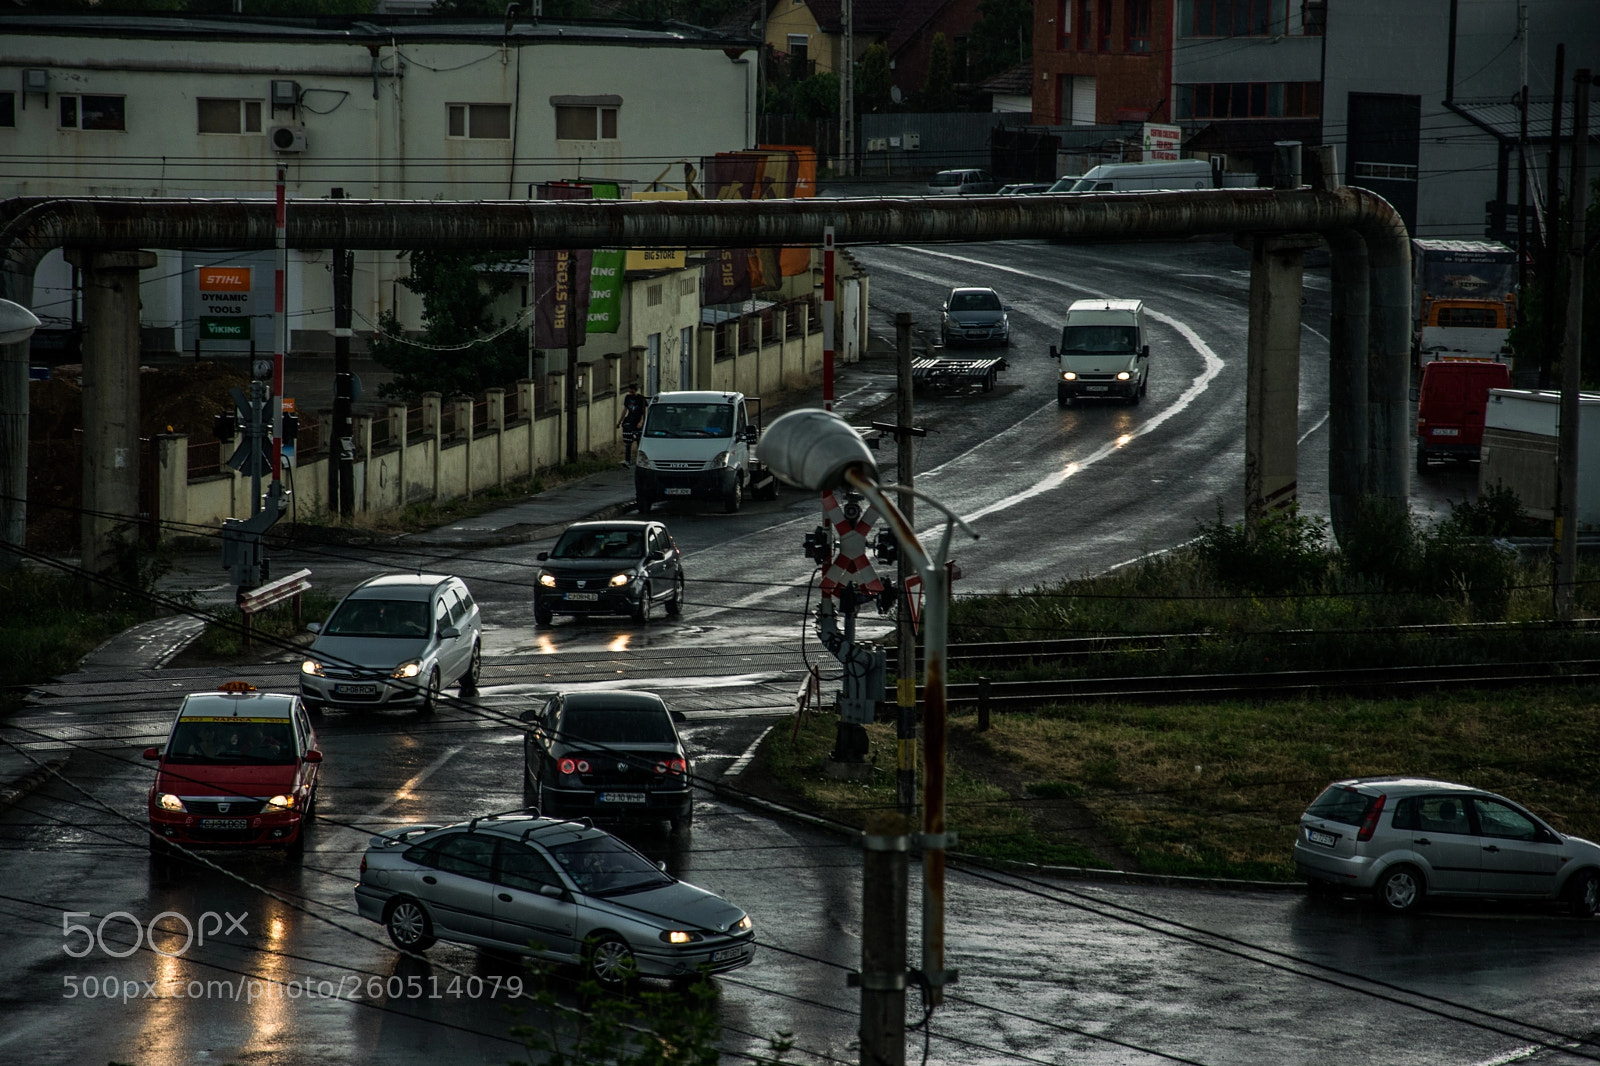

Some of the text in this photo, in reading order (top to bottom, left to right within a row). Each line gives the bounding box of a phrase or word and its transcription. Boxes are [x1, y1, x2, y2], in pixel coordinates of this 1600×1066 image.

[645, 250, 675, 260] BIG STORE
[590, 267, 615, 276] KING
[721, 263, 735, 286] BIG
[206, 275, 242, 284] STIHL
[554, 251, 569, 329] BIG STORE
[587, 312, 609, 321] KING
[208, 323, 241, 334] VIKING
